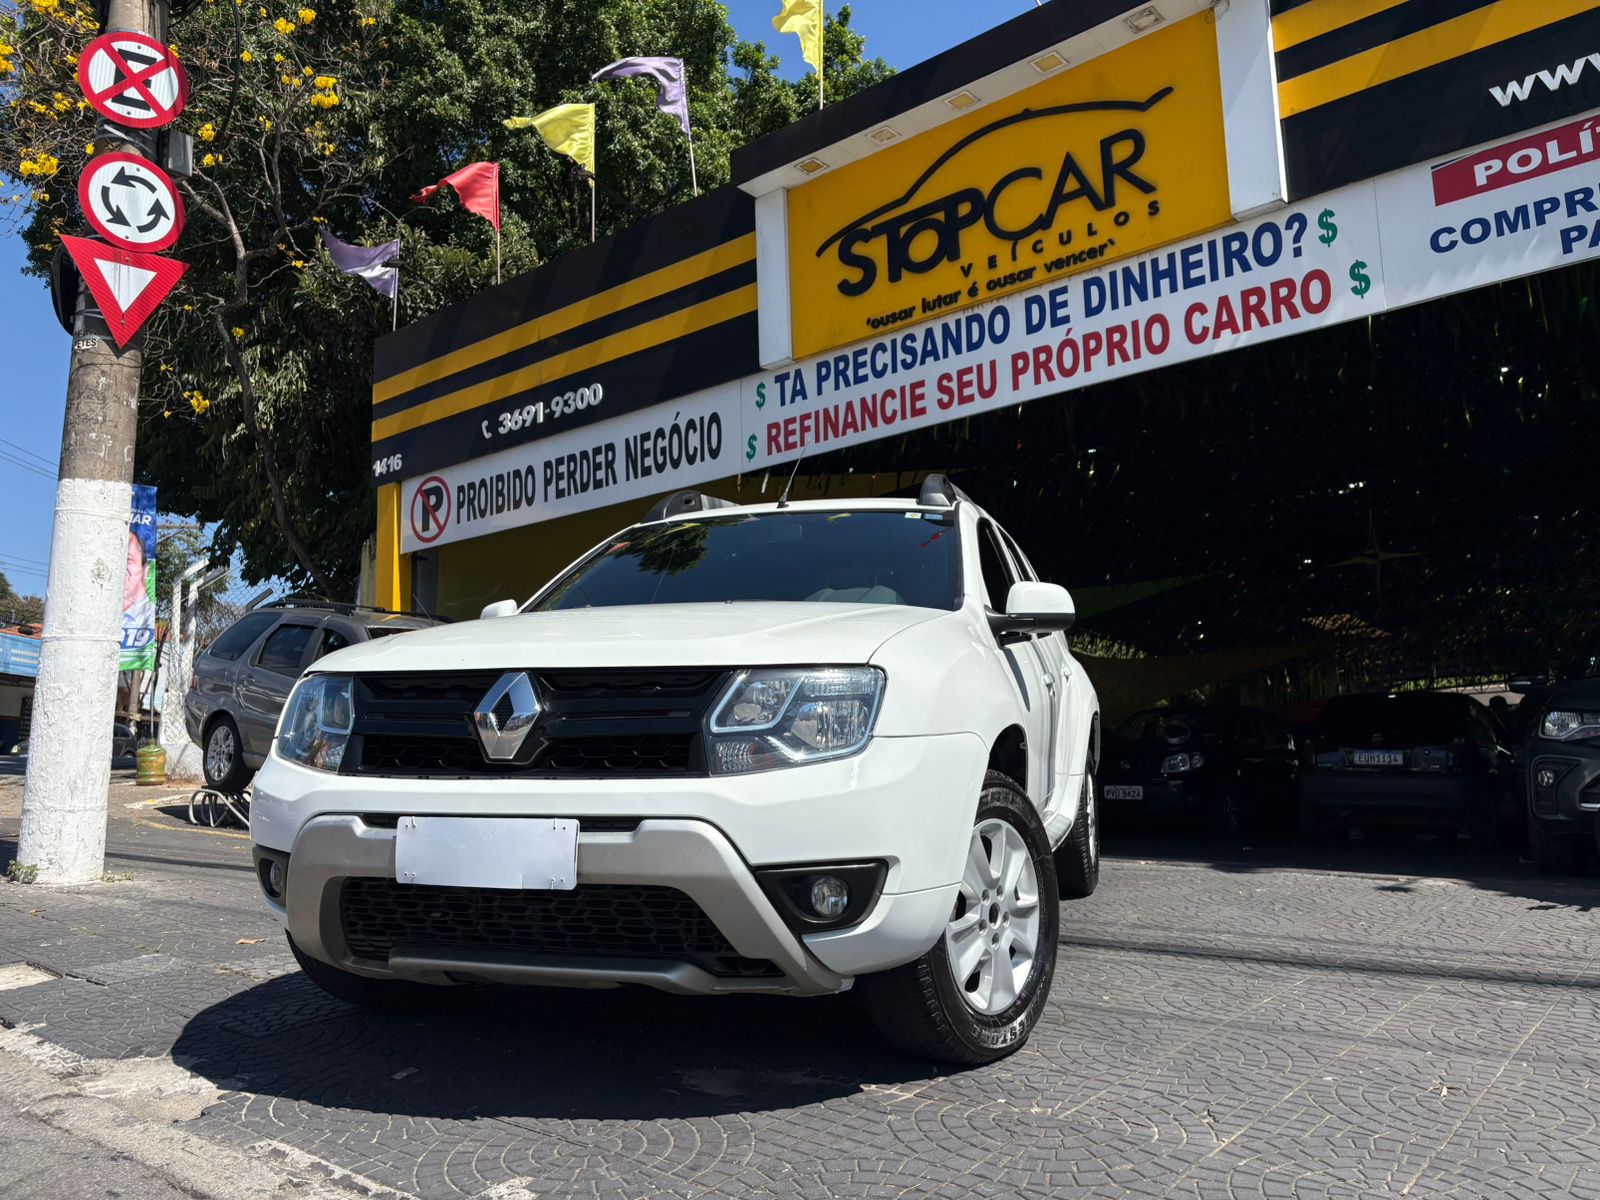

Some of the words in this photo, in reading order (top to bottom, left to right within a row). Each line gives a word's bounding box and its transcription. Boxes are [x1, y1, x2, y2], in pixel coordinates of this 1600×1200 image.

[1489, 52, 1600, 107] ww
[1473, 121, 1600, 187] POLÍ
[1429, 183, 1600, 254] COMPR
[774, 369, 808, 407] TA
[816, 304, 1010, 397] PRECISANDO
[1024, 285, 1070, 336] DE
[1083, 212, 1307, 318] DINHEIRO?
[922, 290, 962, 314] lutar
[967, 281, 979, 298] é
[986, 266, 1037, 292] ousar
[766, 380, 927, 456] REFINANCIE
[936, 359, 997, 411] SEU
[1011, 311, 1170, 392] PRÓPRIO
[1184, 268, 1332, 345] CARRO
[498, 382, 603, 435] 3691-9300
[373, 453, 402, 477] 1416
[456, 464, 536, 525] PROIBIDO
[543, 441, 617, 503] PERDER
[624, 411, 722, 482] NEGÓCIO
